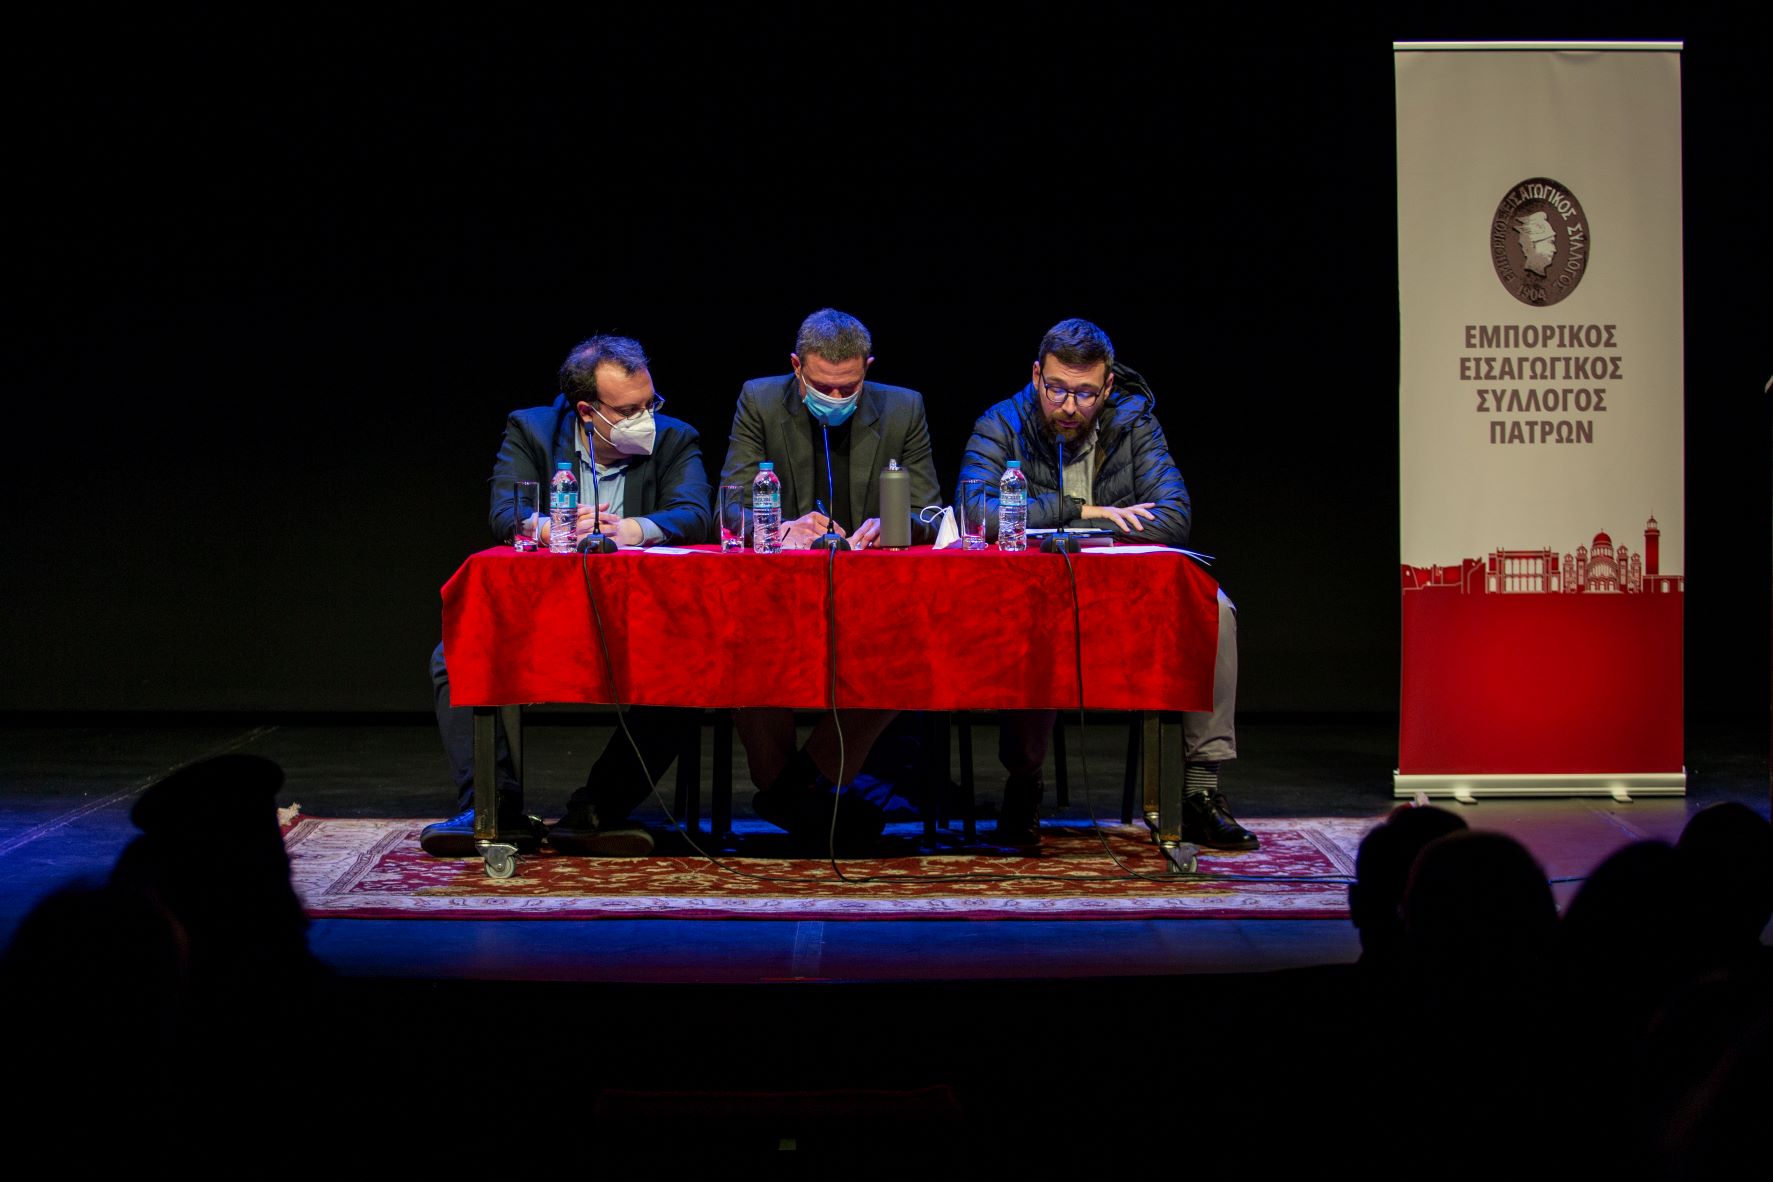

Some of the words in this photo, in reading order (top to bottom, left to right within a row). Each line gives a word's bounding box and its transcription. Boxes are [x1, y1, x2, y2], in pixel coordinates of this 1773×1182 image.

[1518, 284, 1547, 301] 1904
[1465, 324, 1617, 348] ΕΜΠΟΡΙΚΟΣ
[1459, 356, 1623, 380] ΕΙΣΑΓΩΓΙΚΟΣ
[1476, 388, 1607, 412] ΣΥΛΛΟΓΟΣ
[1490, 420, 1593, 444] ΠΑΤΡΩΝ
